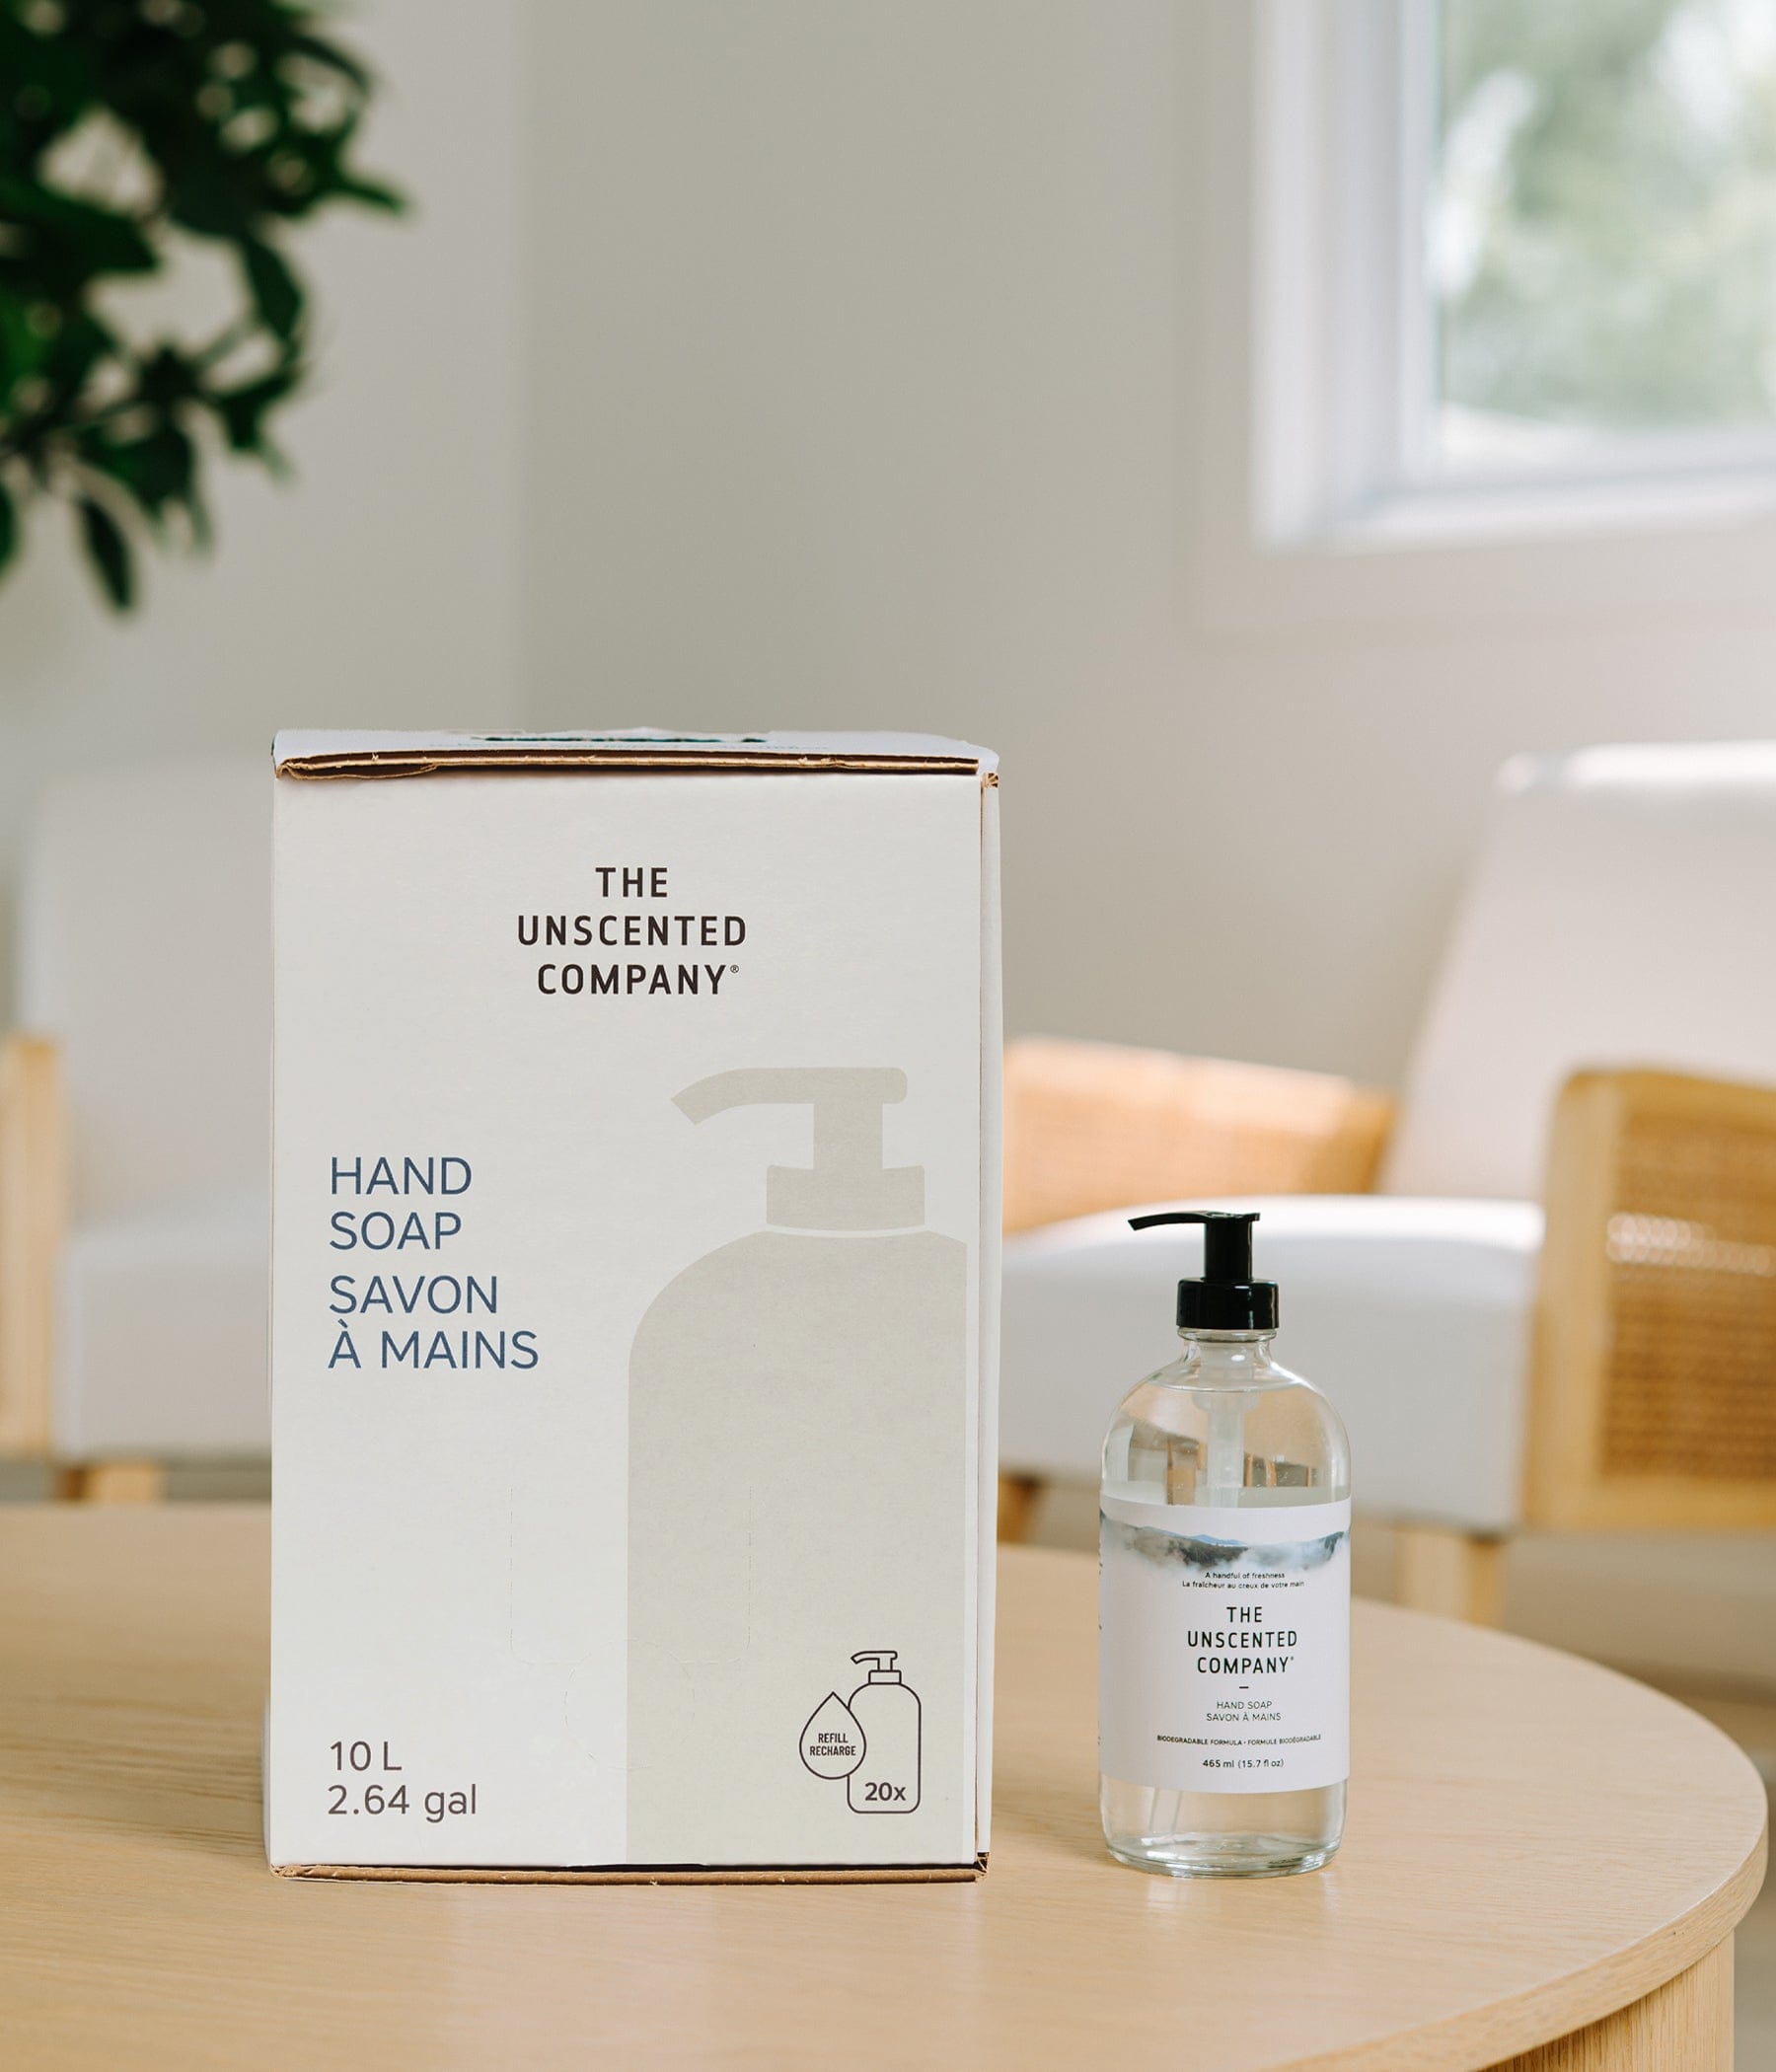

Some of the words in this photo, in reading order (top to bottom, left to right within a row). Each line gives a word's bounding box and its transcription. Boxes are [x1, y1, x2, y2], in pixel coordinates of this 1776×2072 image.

[595, 867, 667, 897] THE
[518, 916, 745, 945] UNSCENTED
[332, 1157, 472, 1195] HAND
[330, 1212, 461, 1250] SOAP
[330, 1276, 496, 1313] SAVON
[329, 1319, 361, 1369] À
[382, 1331, 538, 1369] MAINS
[1226, 1606, 1262, 1623] THE
[1188, 1631, 1296, 1648] UNSCENTED
[1207, 1713, 1239, 1722] SAVON
[1242, 1712, 1249, 1721] À
[809, 1744, 856, 1756] RECHARGE
[818, 1734, 849, 1743] REFILL
[1157, 1735, 1208, 1744] BIODEGRADABLE
[331, 1741, 371, 1771] 10
[384, 1741, 402, 1770] L
[329, 1785, 409, 1814] 2.64
[425, 1784, 476, 1823] gal
[865, 1782, 906, 1801] 20x
